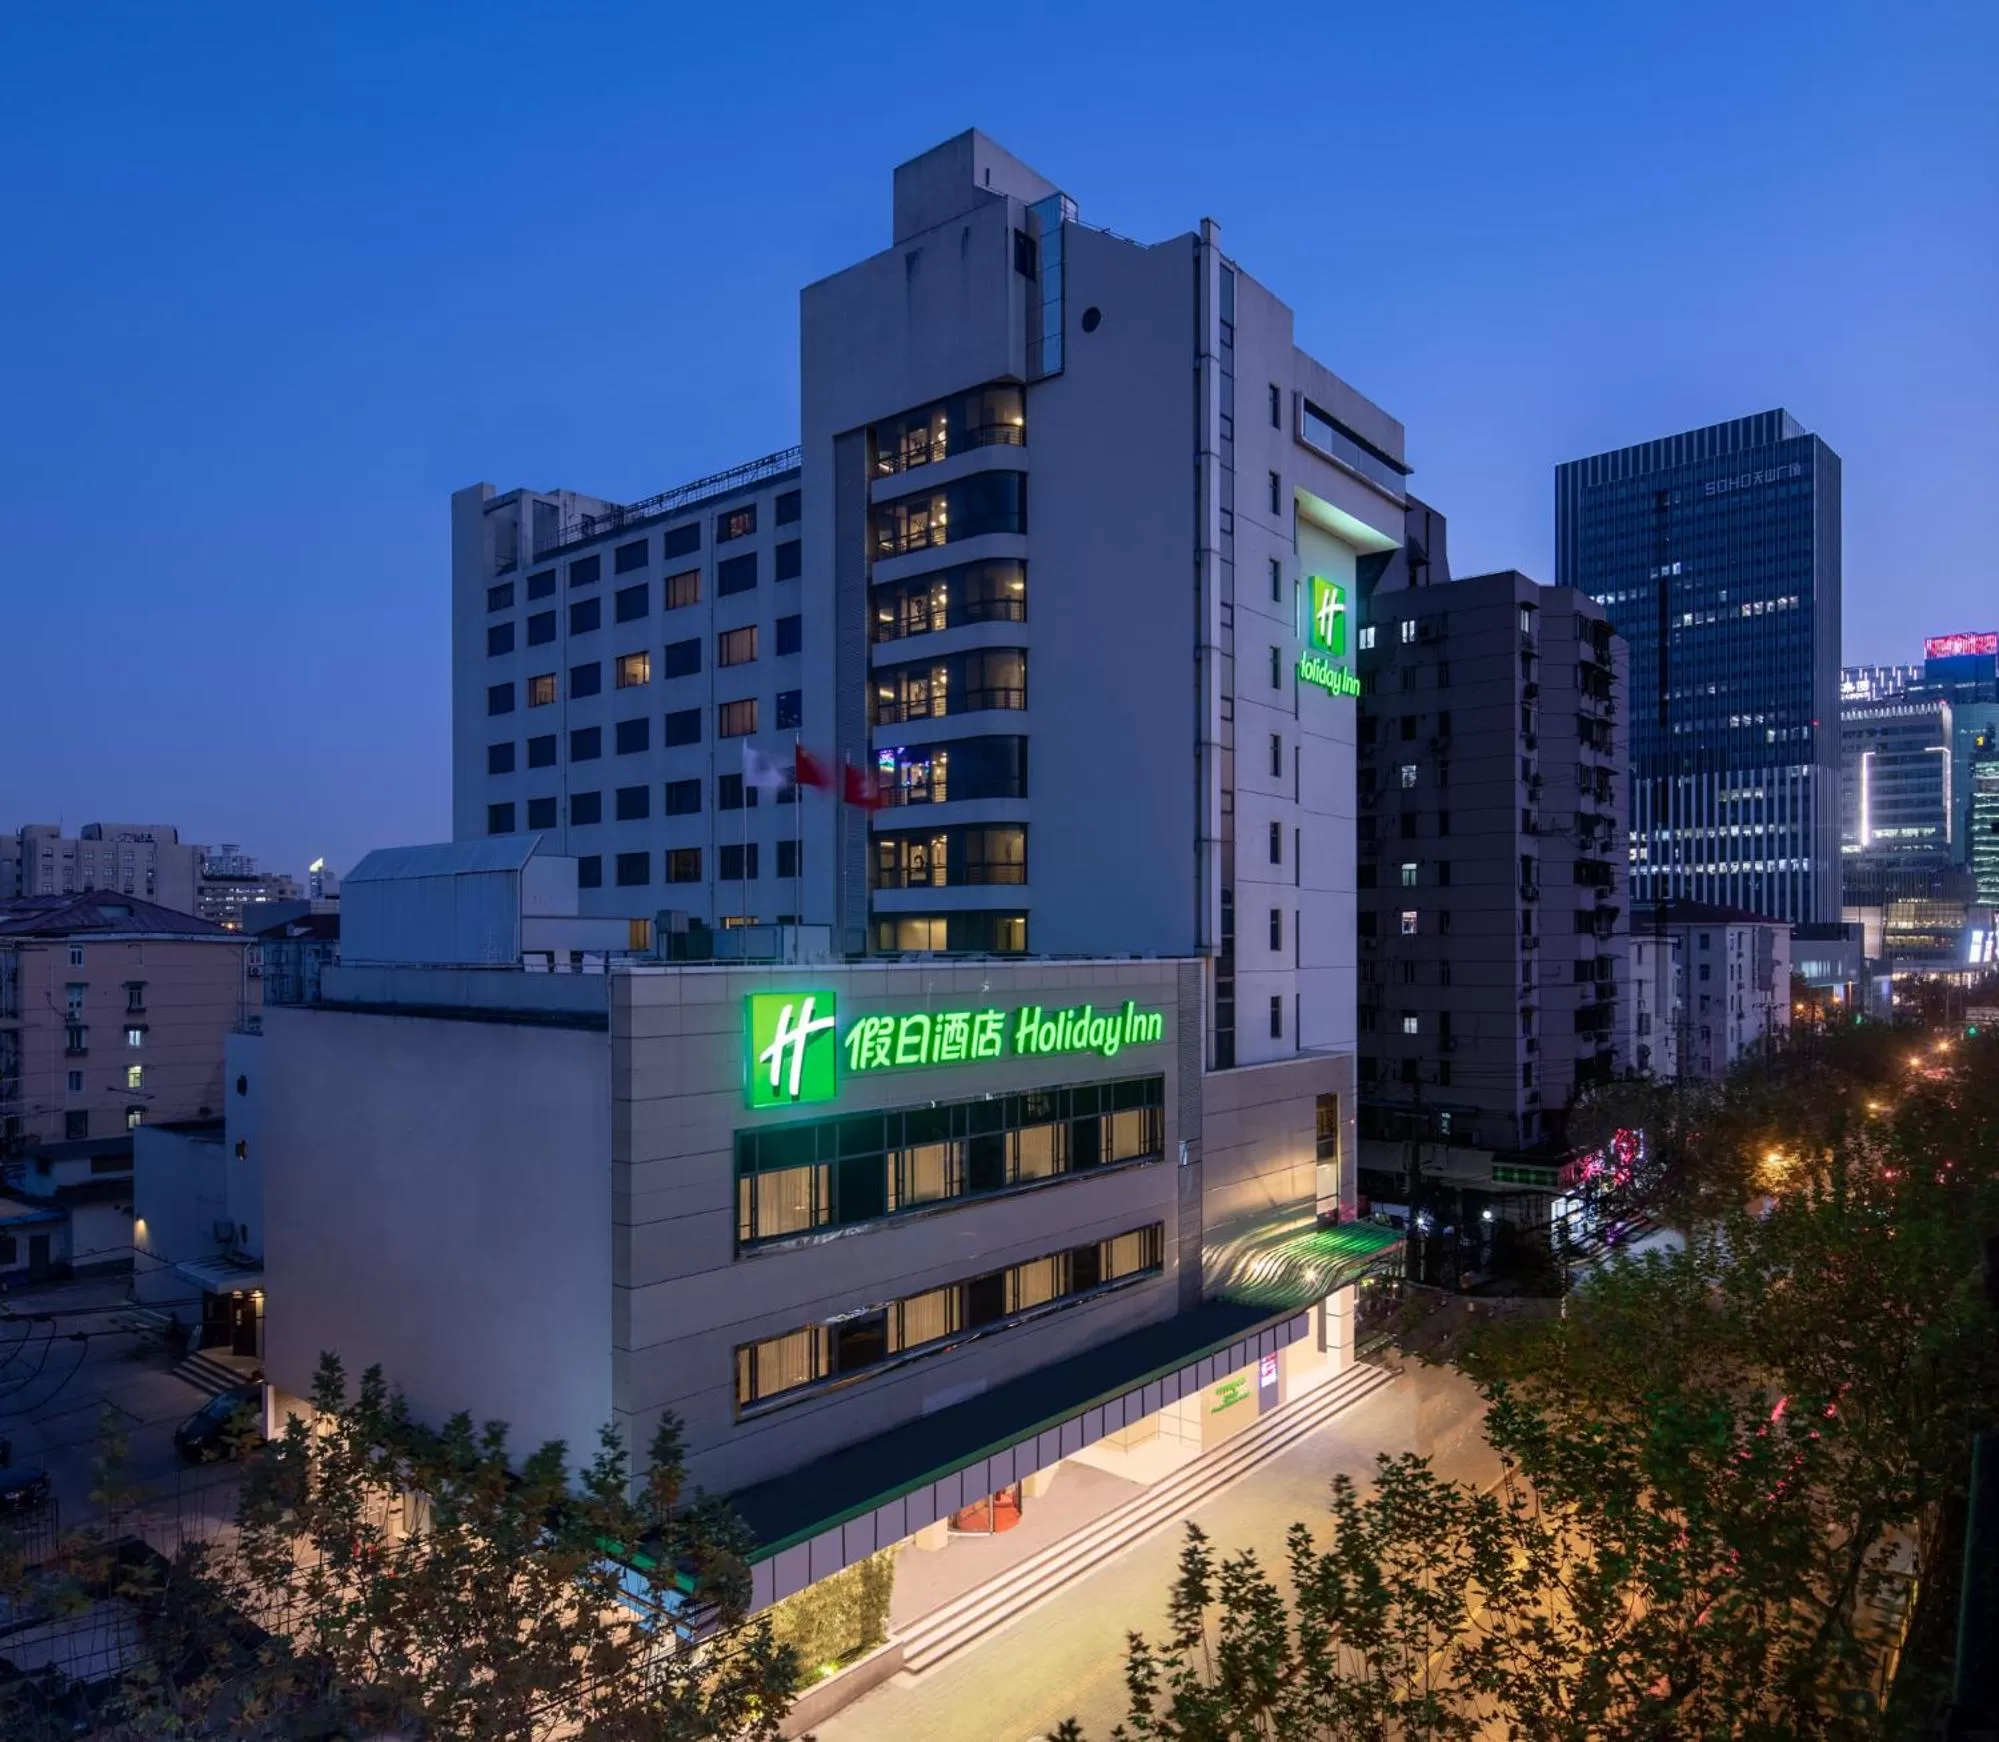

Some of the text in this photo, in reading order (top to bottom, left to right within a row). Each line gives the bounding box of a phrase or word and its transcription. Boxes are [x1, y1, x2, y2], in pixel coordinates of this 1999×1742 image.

[1342, 666, 1361, 697] Inn
[846, 1010, 1006, 1070] 假日酒店
[1015, 1001, 1163, 1056] Holiday Inn
